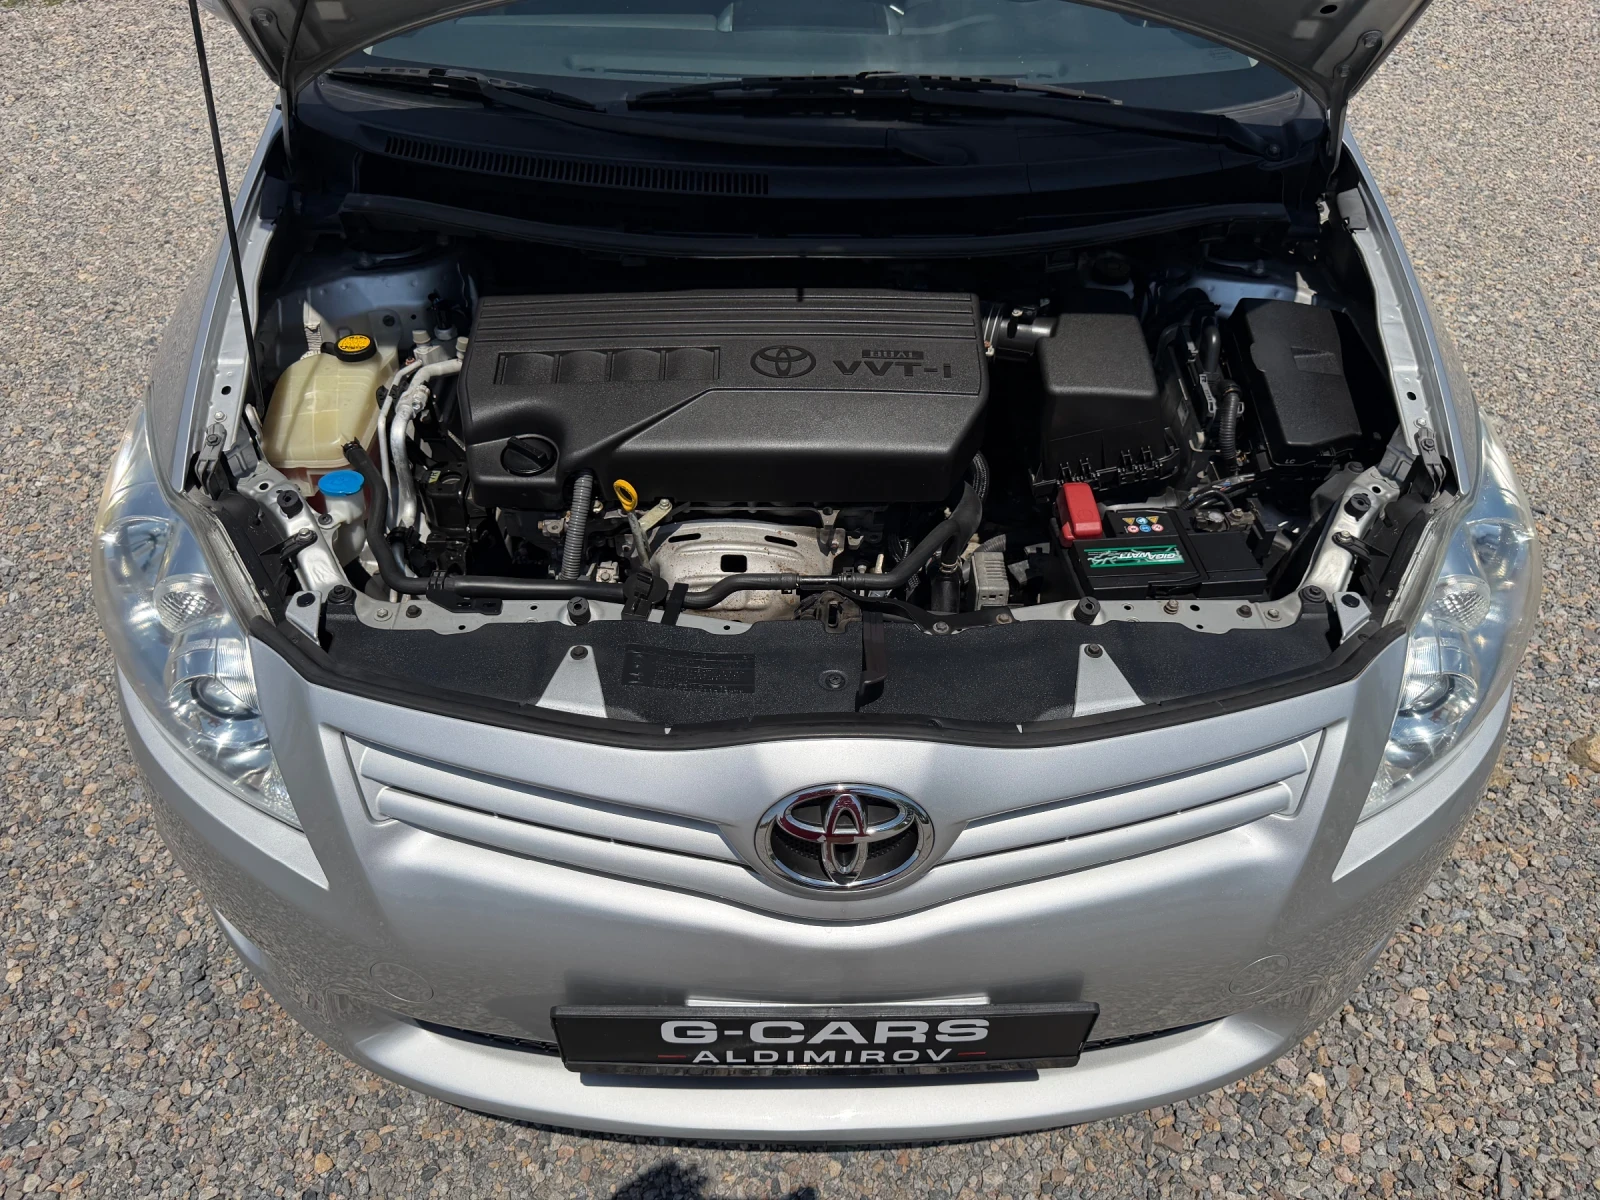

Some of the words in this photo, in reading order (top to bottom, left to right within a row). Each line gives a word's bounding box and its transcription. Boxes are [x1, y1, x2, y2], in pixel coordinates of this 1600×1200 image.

[1117, 551, 1176, 561] GIGAWATT
[660, 1019, 990, 1044] G-CARS
[692, 1048, 953, 1064] ALDIMIROV
